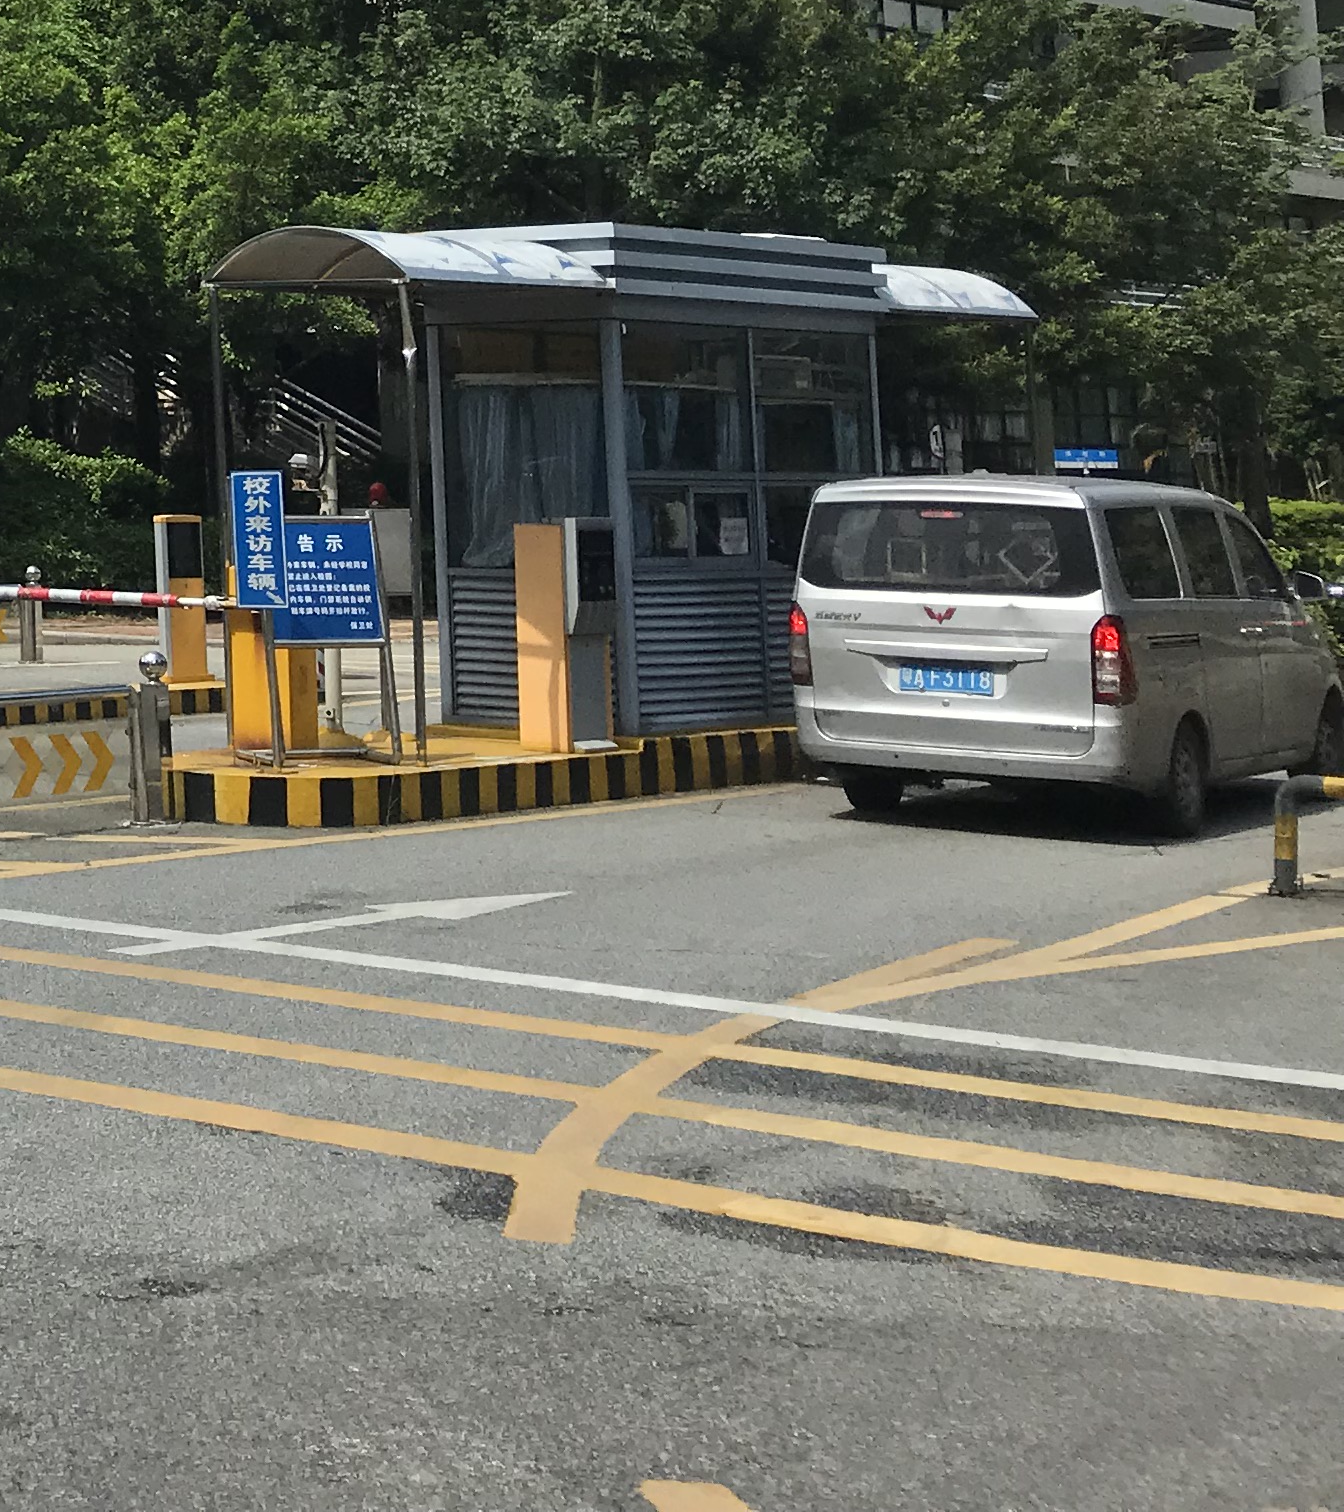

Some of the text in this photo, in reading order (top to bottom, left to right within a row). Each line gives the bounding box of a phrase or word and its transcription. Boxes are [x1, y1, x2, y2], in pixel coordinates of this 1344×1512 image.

[242, 476, 278, 591] 校外来访车辆
[296, 533, 344, 553] 告示
